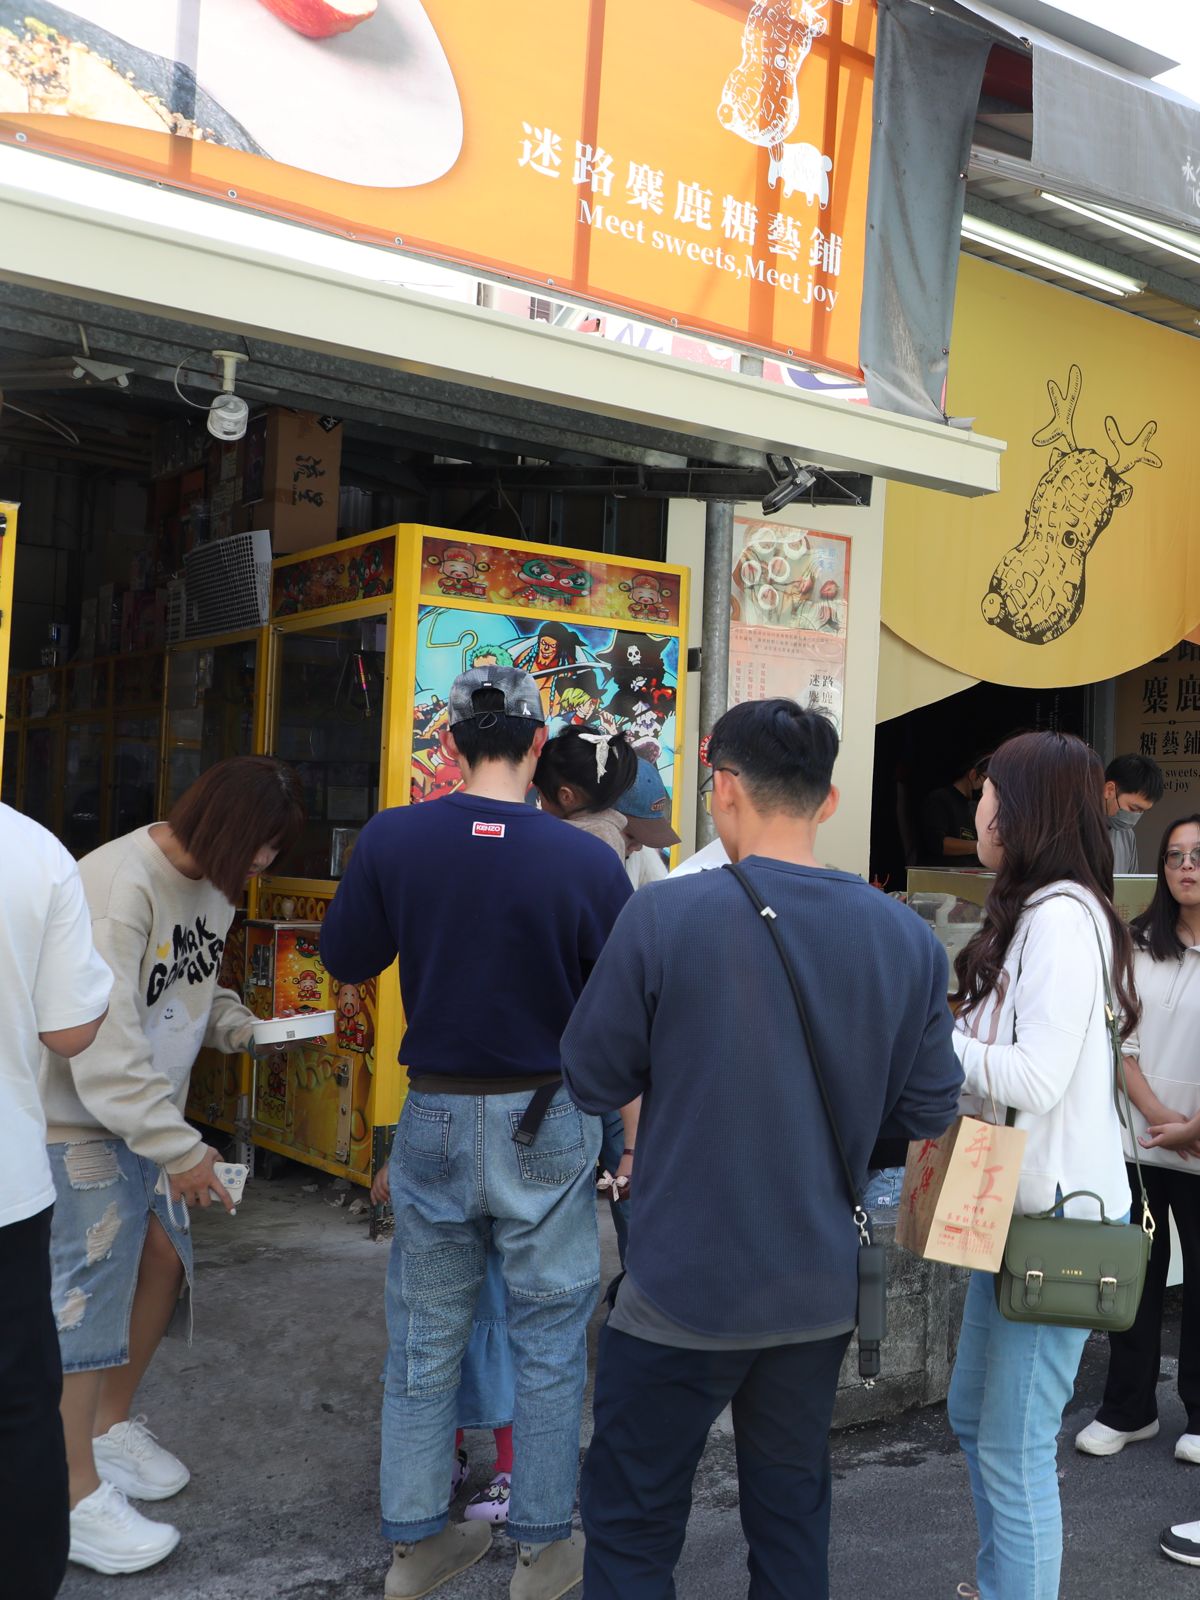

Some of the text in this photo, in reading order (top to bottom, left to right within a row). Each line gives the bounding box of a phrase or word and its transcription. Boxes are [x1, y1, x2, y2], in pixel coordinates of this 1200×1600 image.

[518, 121, 843, 277] 迷路麋鹿糖藝鋪
[577, 199, 645, 248] Meet
[802, 273, 839, 312] joy
[1174, 779, 1190, 792] joy
[475, 824, 501, 834] KENZO
